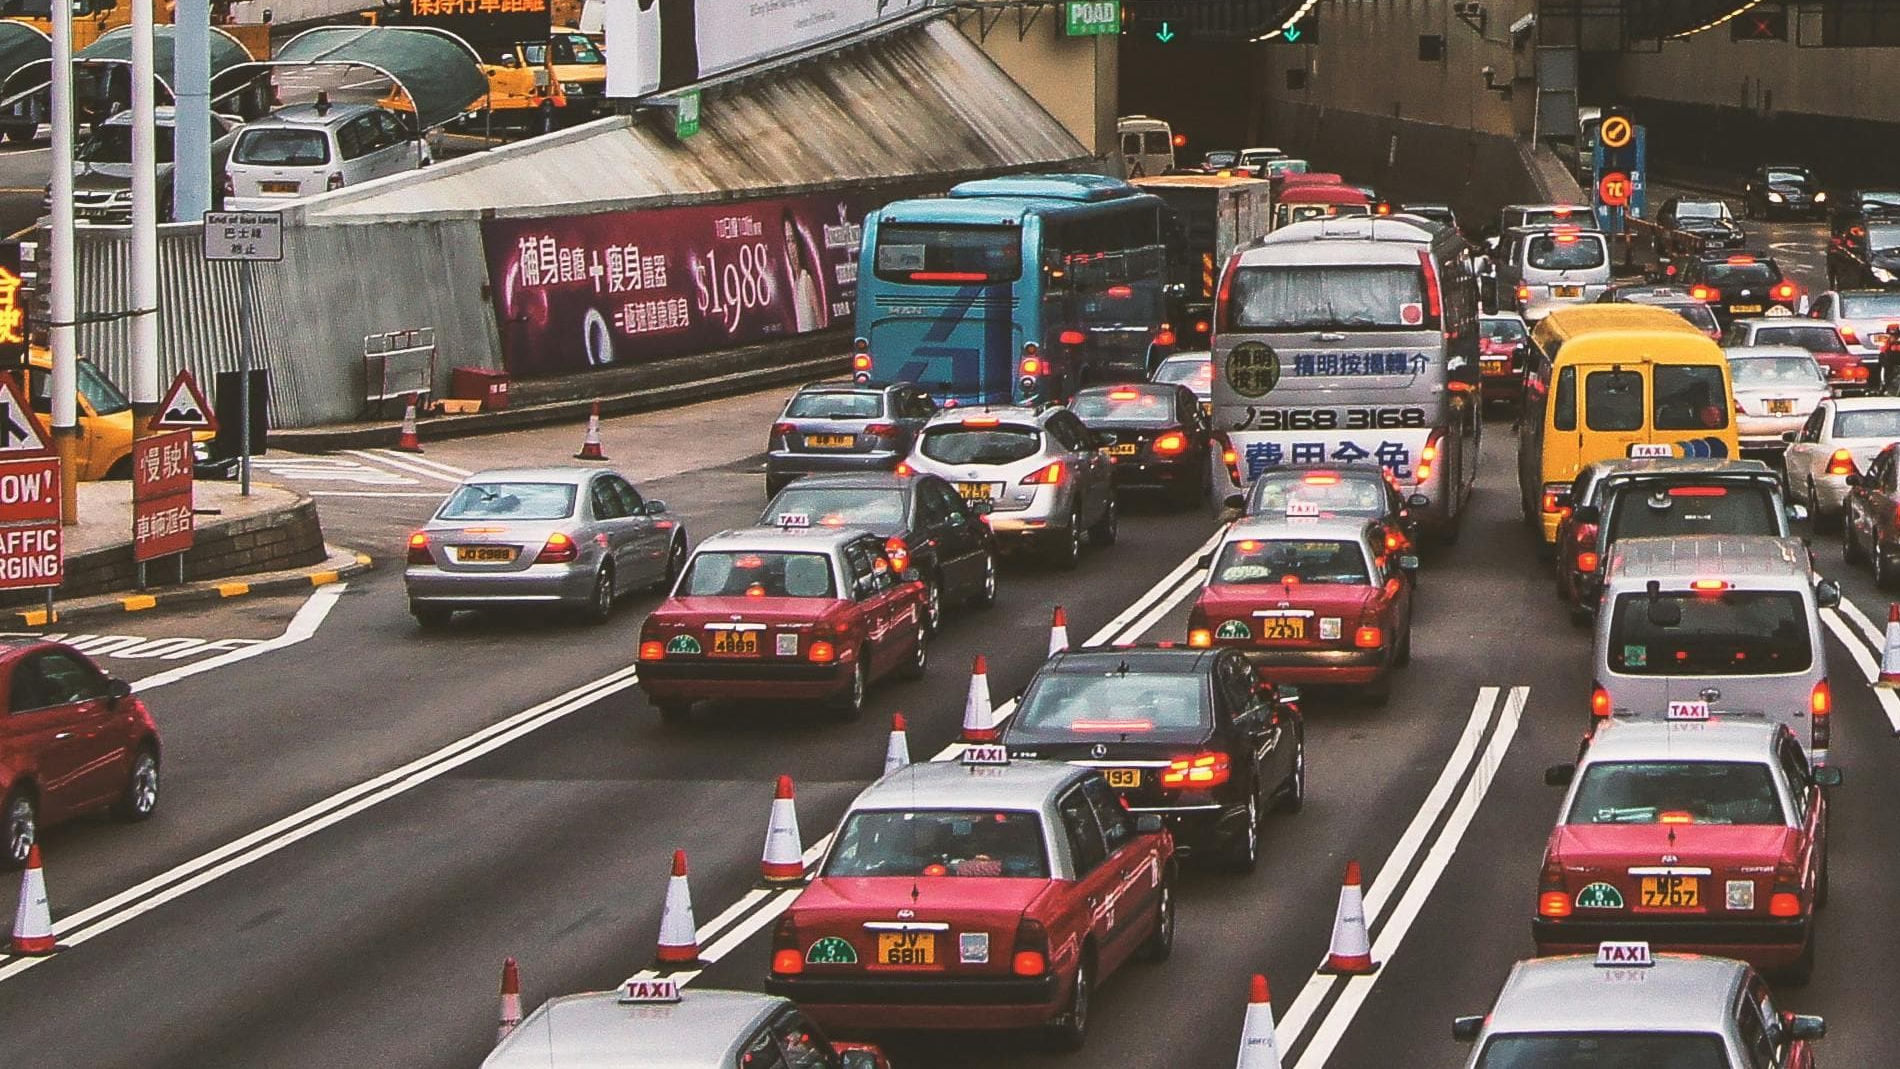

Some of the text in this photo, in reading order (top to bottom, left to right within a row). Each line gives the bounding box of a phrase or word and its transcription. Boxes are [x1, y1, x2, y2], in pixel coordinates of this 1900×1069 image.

[695, 243, 770, 333] $1,988
[1259, 408, 1426, 430] 3168 3168
[1637, 447, 1666, 455] TAXI
[140, 441, 188, 484] 慢駛!
[781, 516, 805, 524] TAXI
[1671, 705, 1705, 717] TAXI
[967, 748, 1003, 761] TAXI
[888, 947, 927, 964] 6811
[1602, 946, 1646, 961] TAXI
[628, 983, 672, 998] TAXI
